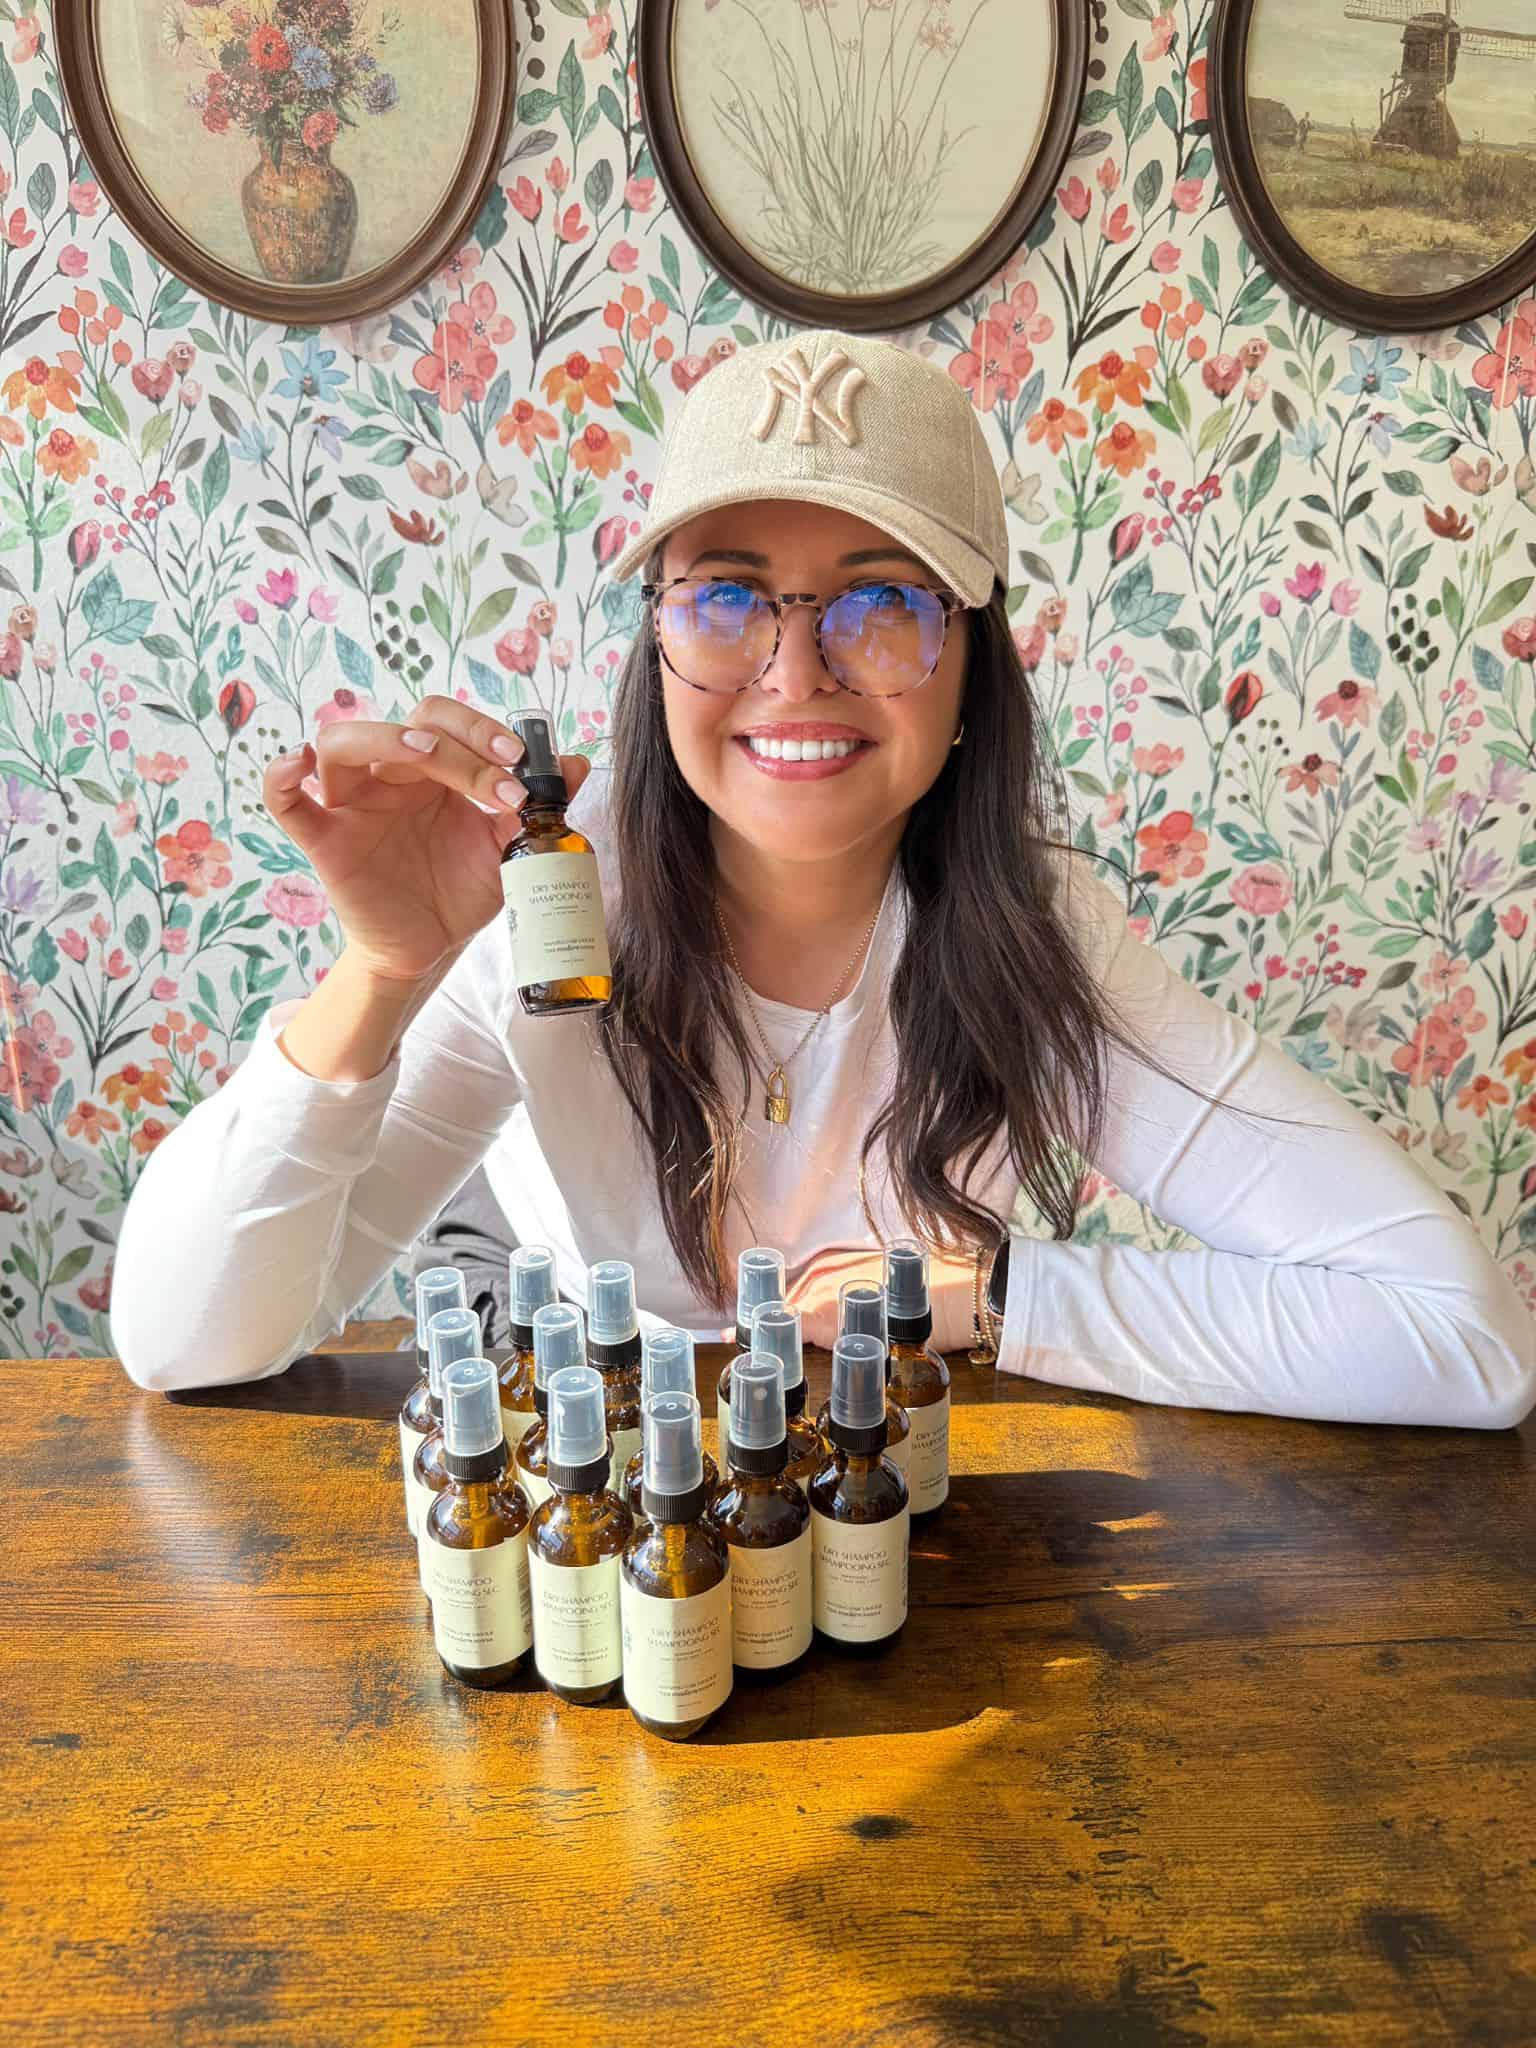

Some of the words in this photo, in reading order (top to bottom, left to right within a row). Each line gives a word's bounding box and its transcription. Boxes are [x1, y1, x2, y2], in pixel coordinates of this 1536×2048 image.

[751, 347, 867, 448] NY
[550, 880, 590, 890] SHAMPOO
[841, 1550, 888, 1561] SHAMPOO
[446, 1575, 493, 1586] SHAMPOO
[751, 1569, 797, 1585] SHAMPOO
[562, 1591, 609, 1605] SHAMPOO
[673, 1616, 719, 1638] SHAMPOO
